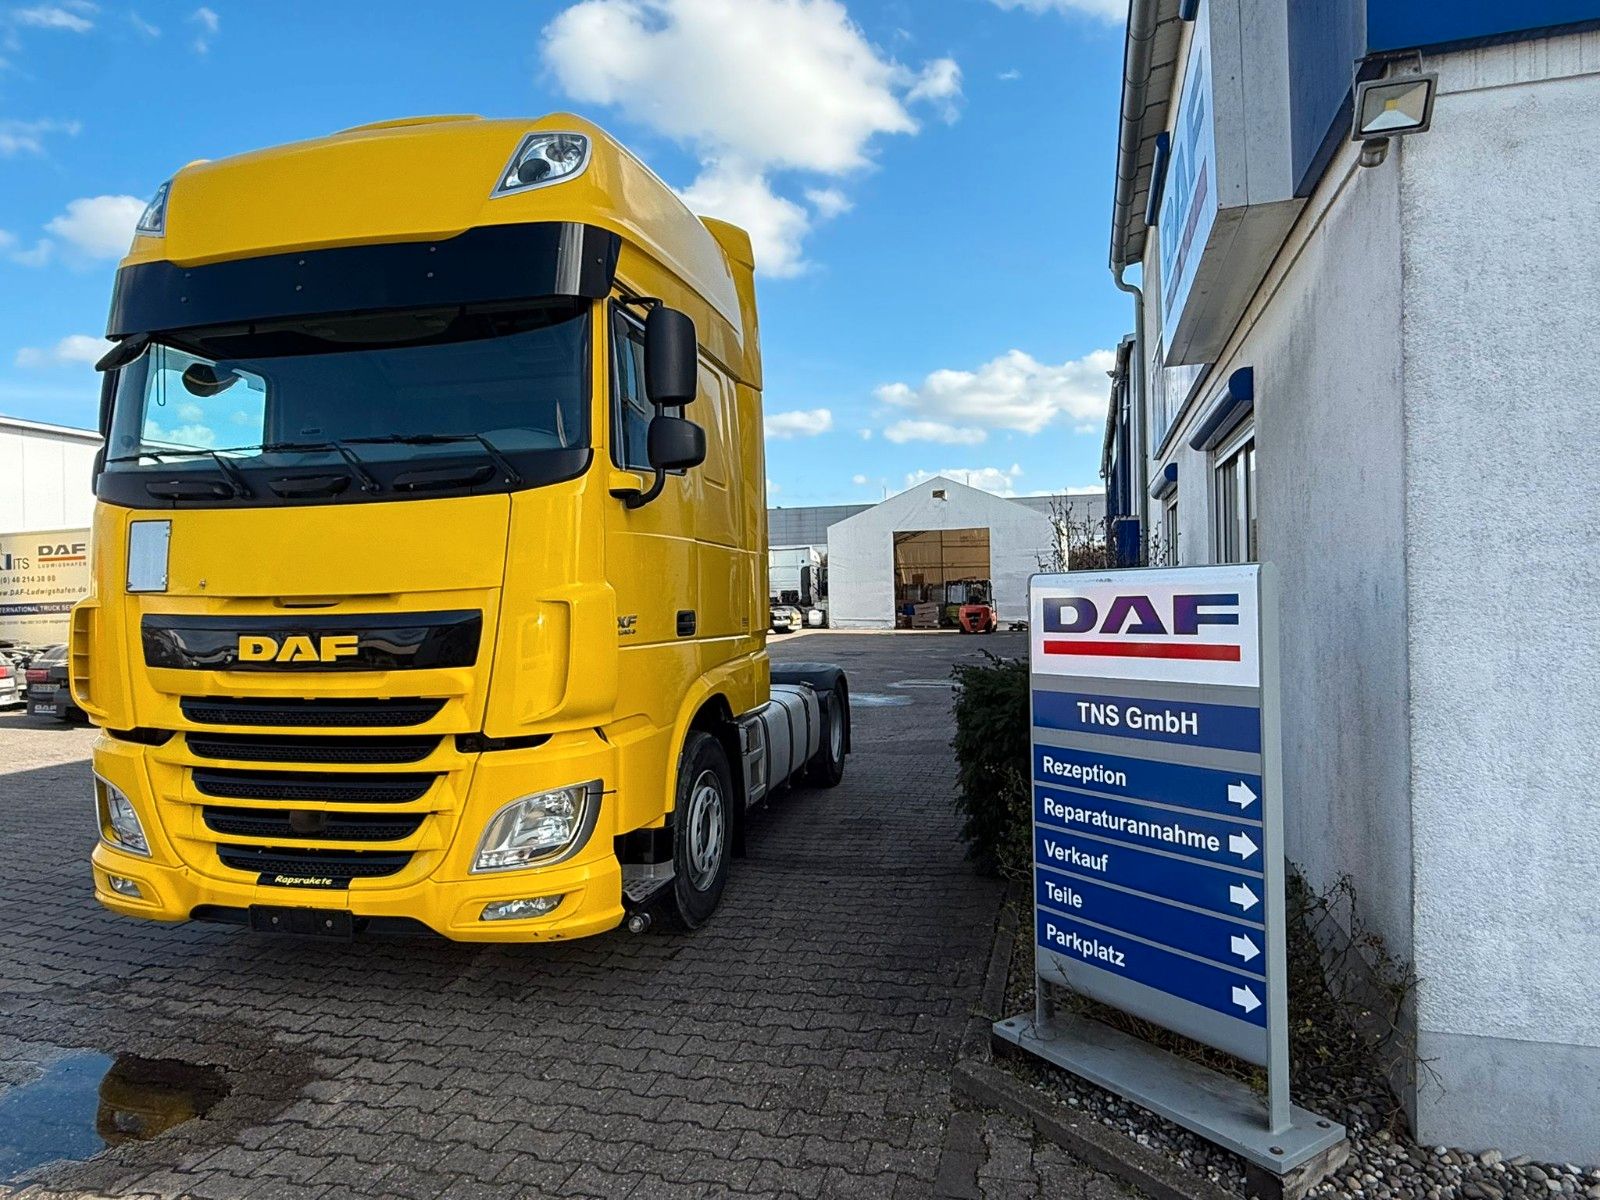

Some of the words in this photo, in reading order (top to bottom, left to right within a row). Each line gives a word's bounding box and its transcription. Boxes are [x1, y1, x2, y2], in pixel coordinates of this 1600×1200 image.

[38, 543, 86, 556] DAF
[40, 604, 61, 612] TRUCK
[1042, 593, 1239, 635] DAF
[238, 635, 358, 662] DAF
[1077, 701, 1119, 726] TNS
[1125, 706, 1198, 735] GmbH
[1043, 755, 1127, 787] Rezeption
[1044, 797, 1220, 852] Reparaturannahme
[1044, 839, 1108, 872] Verkauf
[274, 874, 333, 886] Rapsrakete
[1045, 881, 1083, 908] Teile
[1046, 923, 1126, 967] Parkplatz
